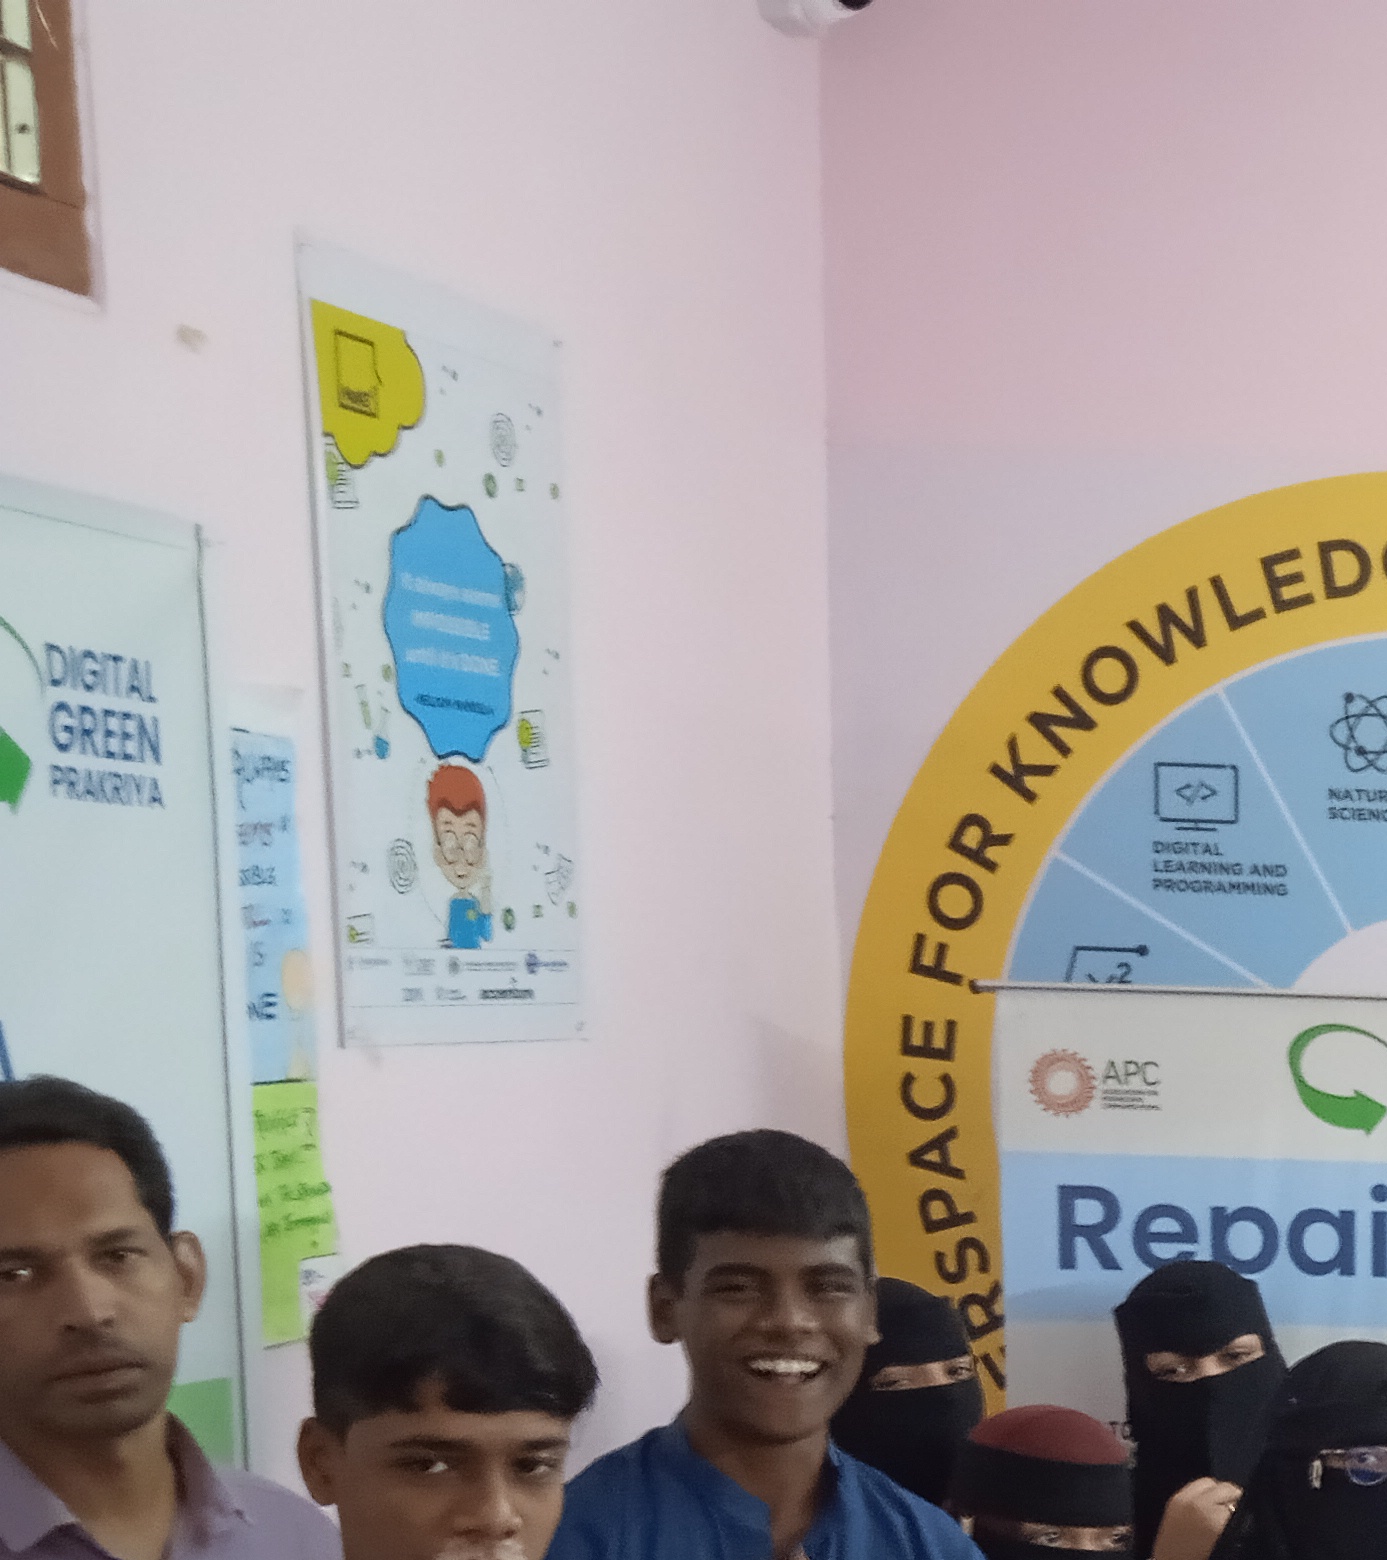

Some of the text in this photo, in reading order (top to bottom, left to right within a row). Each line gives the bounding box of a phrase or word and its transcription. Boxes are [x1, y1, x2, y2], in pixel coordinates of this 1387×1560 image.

[45, 641, 158, 704] DIGITAL
[49, 700, 162, 766] GREEN
[49, 763, 165, 809] PRAKRIYA
[1152, 840, 1224, 857] DIGITAL
[1152, 859, 1288, 878] LEARNING AND
[910, 812, 1015, 986] FOR
[1152, 878, 1289, 897] PROGRAMMING
[1102, 1059, 1161, 1086] APC
